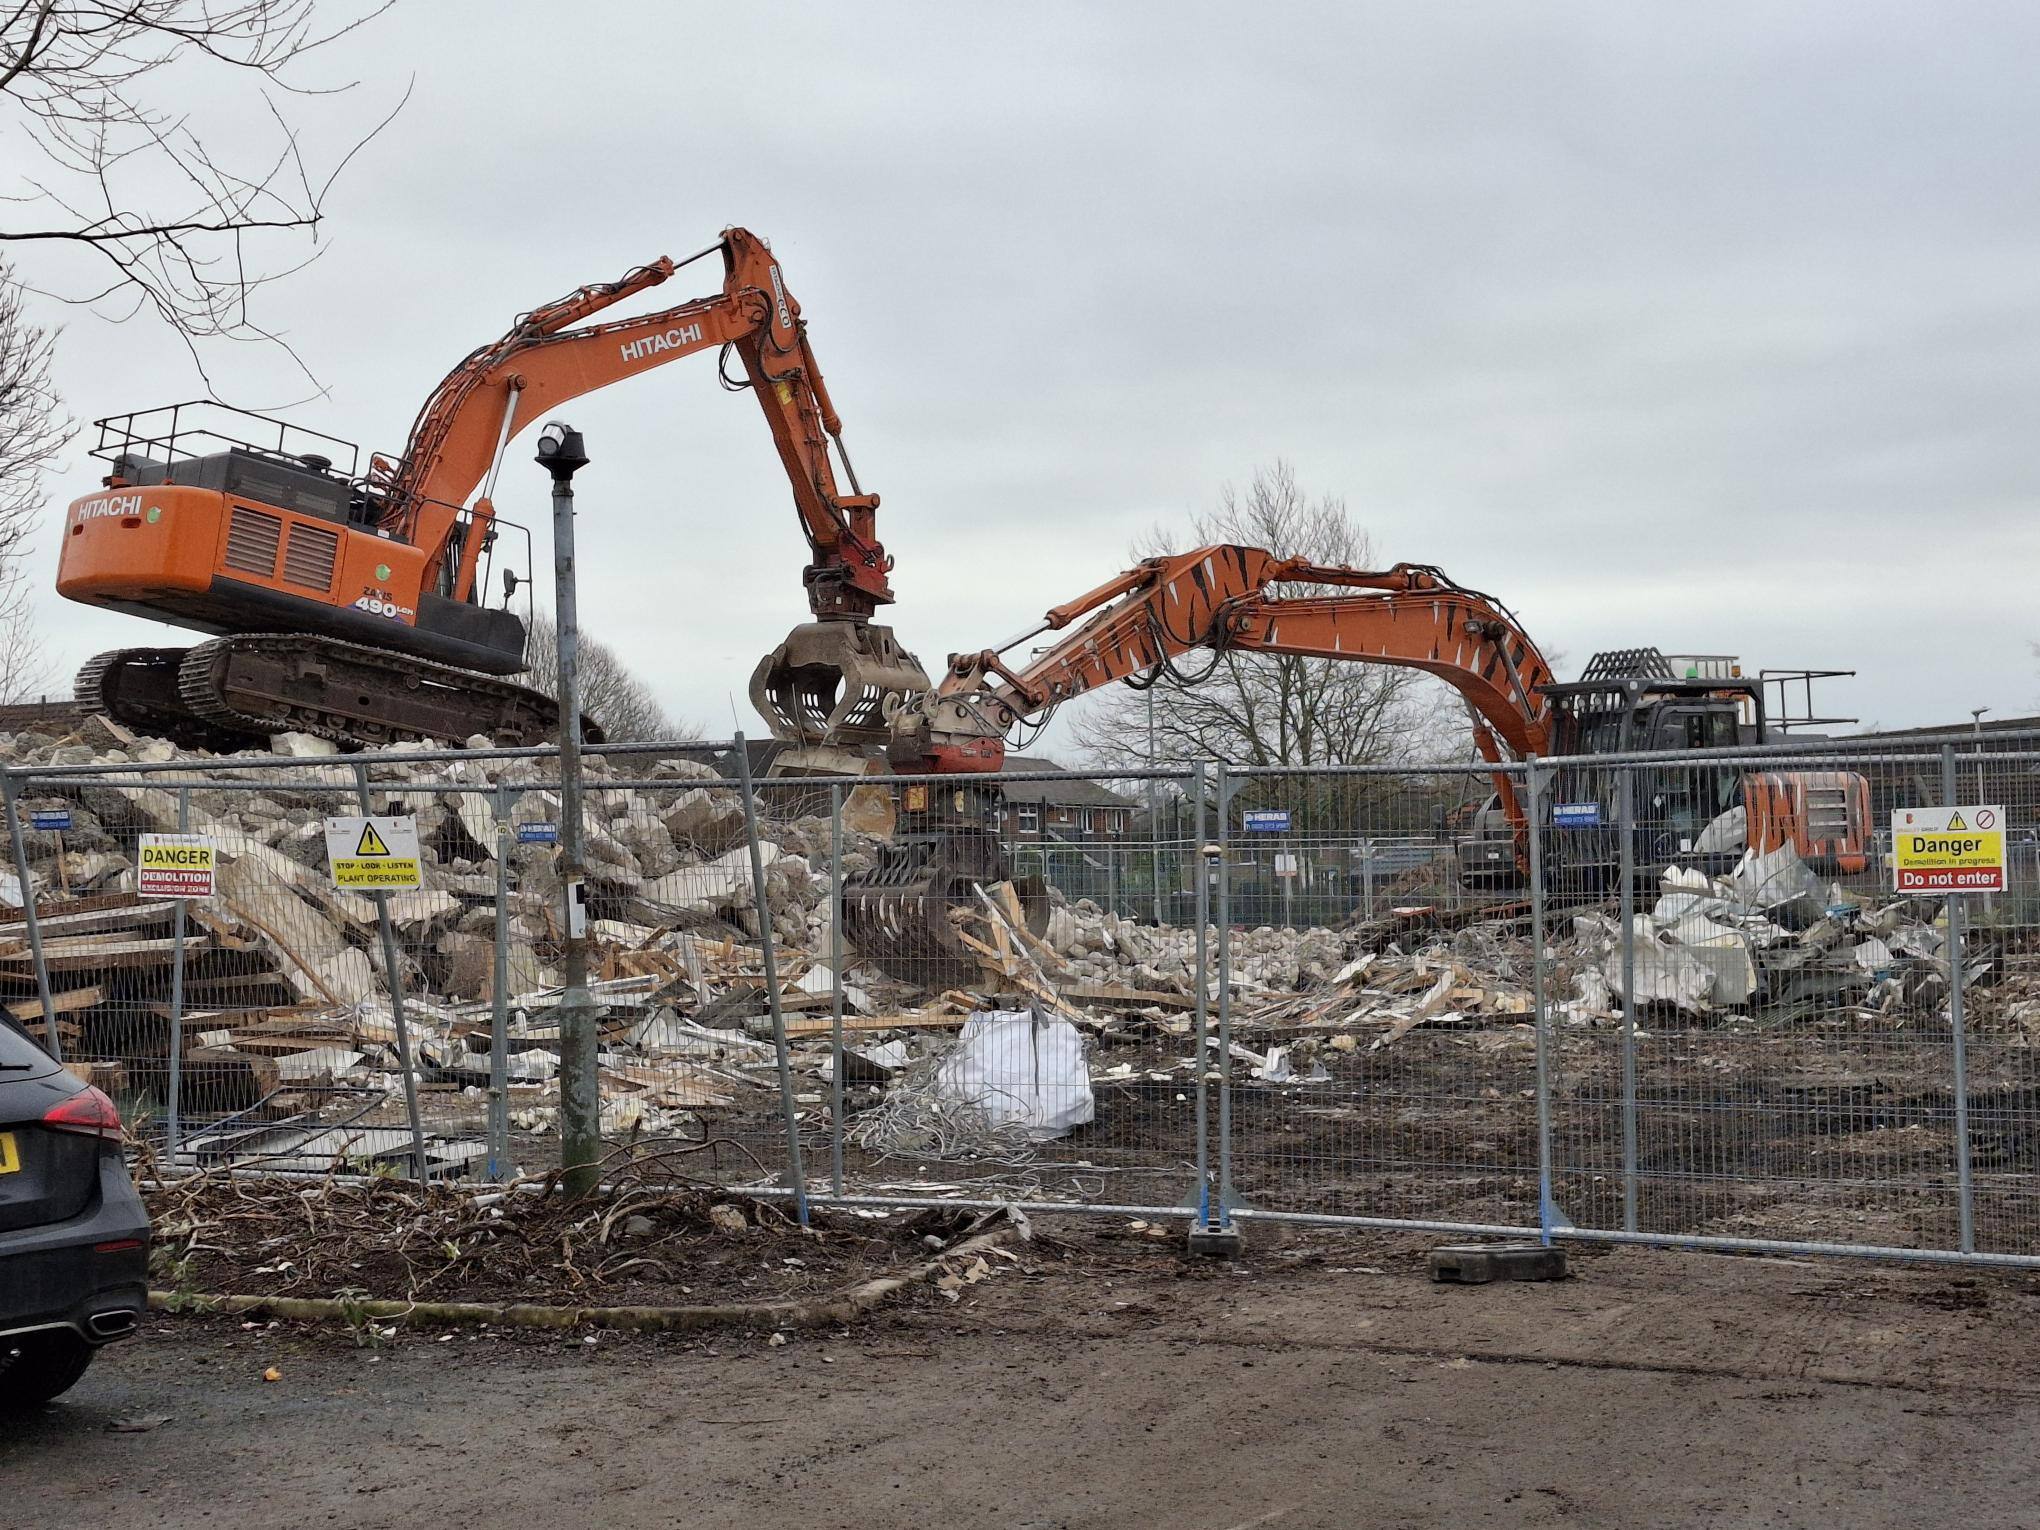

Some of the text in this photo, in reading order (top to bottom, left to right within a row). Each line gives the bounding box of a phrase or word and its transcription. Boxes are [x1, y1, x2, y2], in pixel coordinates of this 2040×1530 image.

[620, 323, 702, 362] HITACHI
[78, 496, 142, 521] HITACHI
[355, 596, 397, 618] 490
[1913, 837, 1982, 856] Danger
[144, 849, 209, 864] DANGER
[1903, 858, 1947, 866] Demolition
[1958, 857, 1996, 867] progress
[336, 862, 355, 870] STOP
[361, 862, 381, 870] LOOK
[142, 871, 210, 883] DEMOLITION
[337, 874, 416, 882] PLANT OPERATING
[1903, 871, 1997, 886] Do not enter
